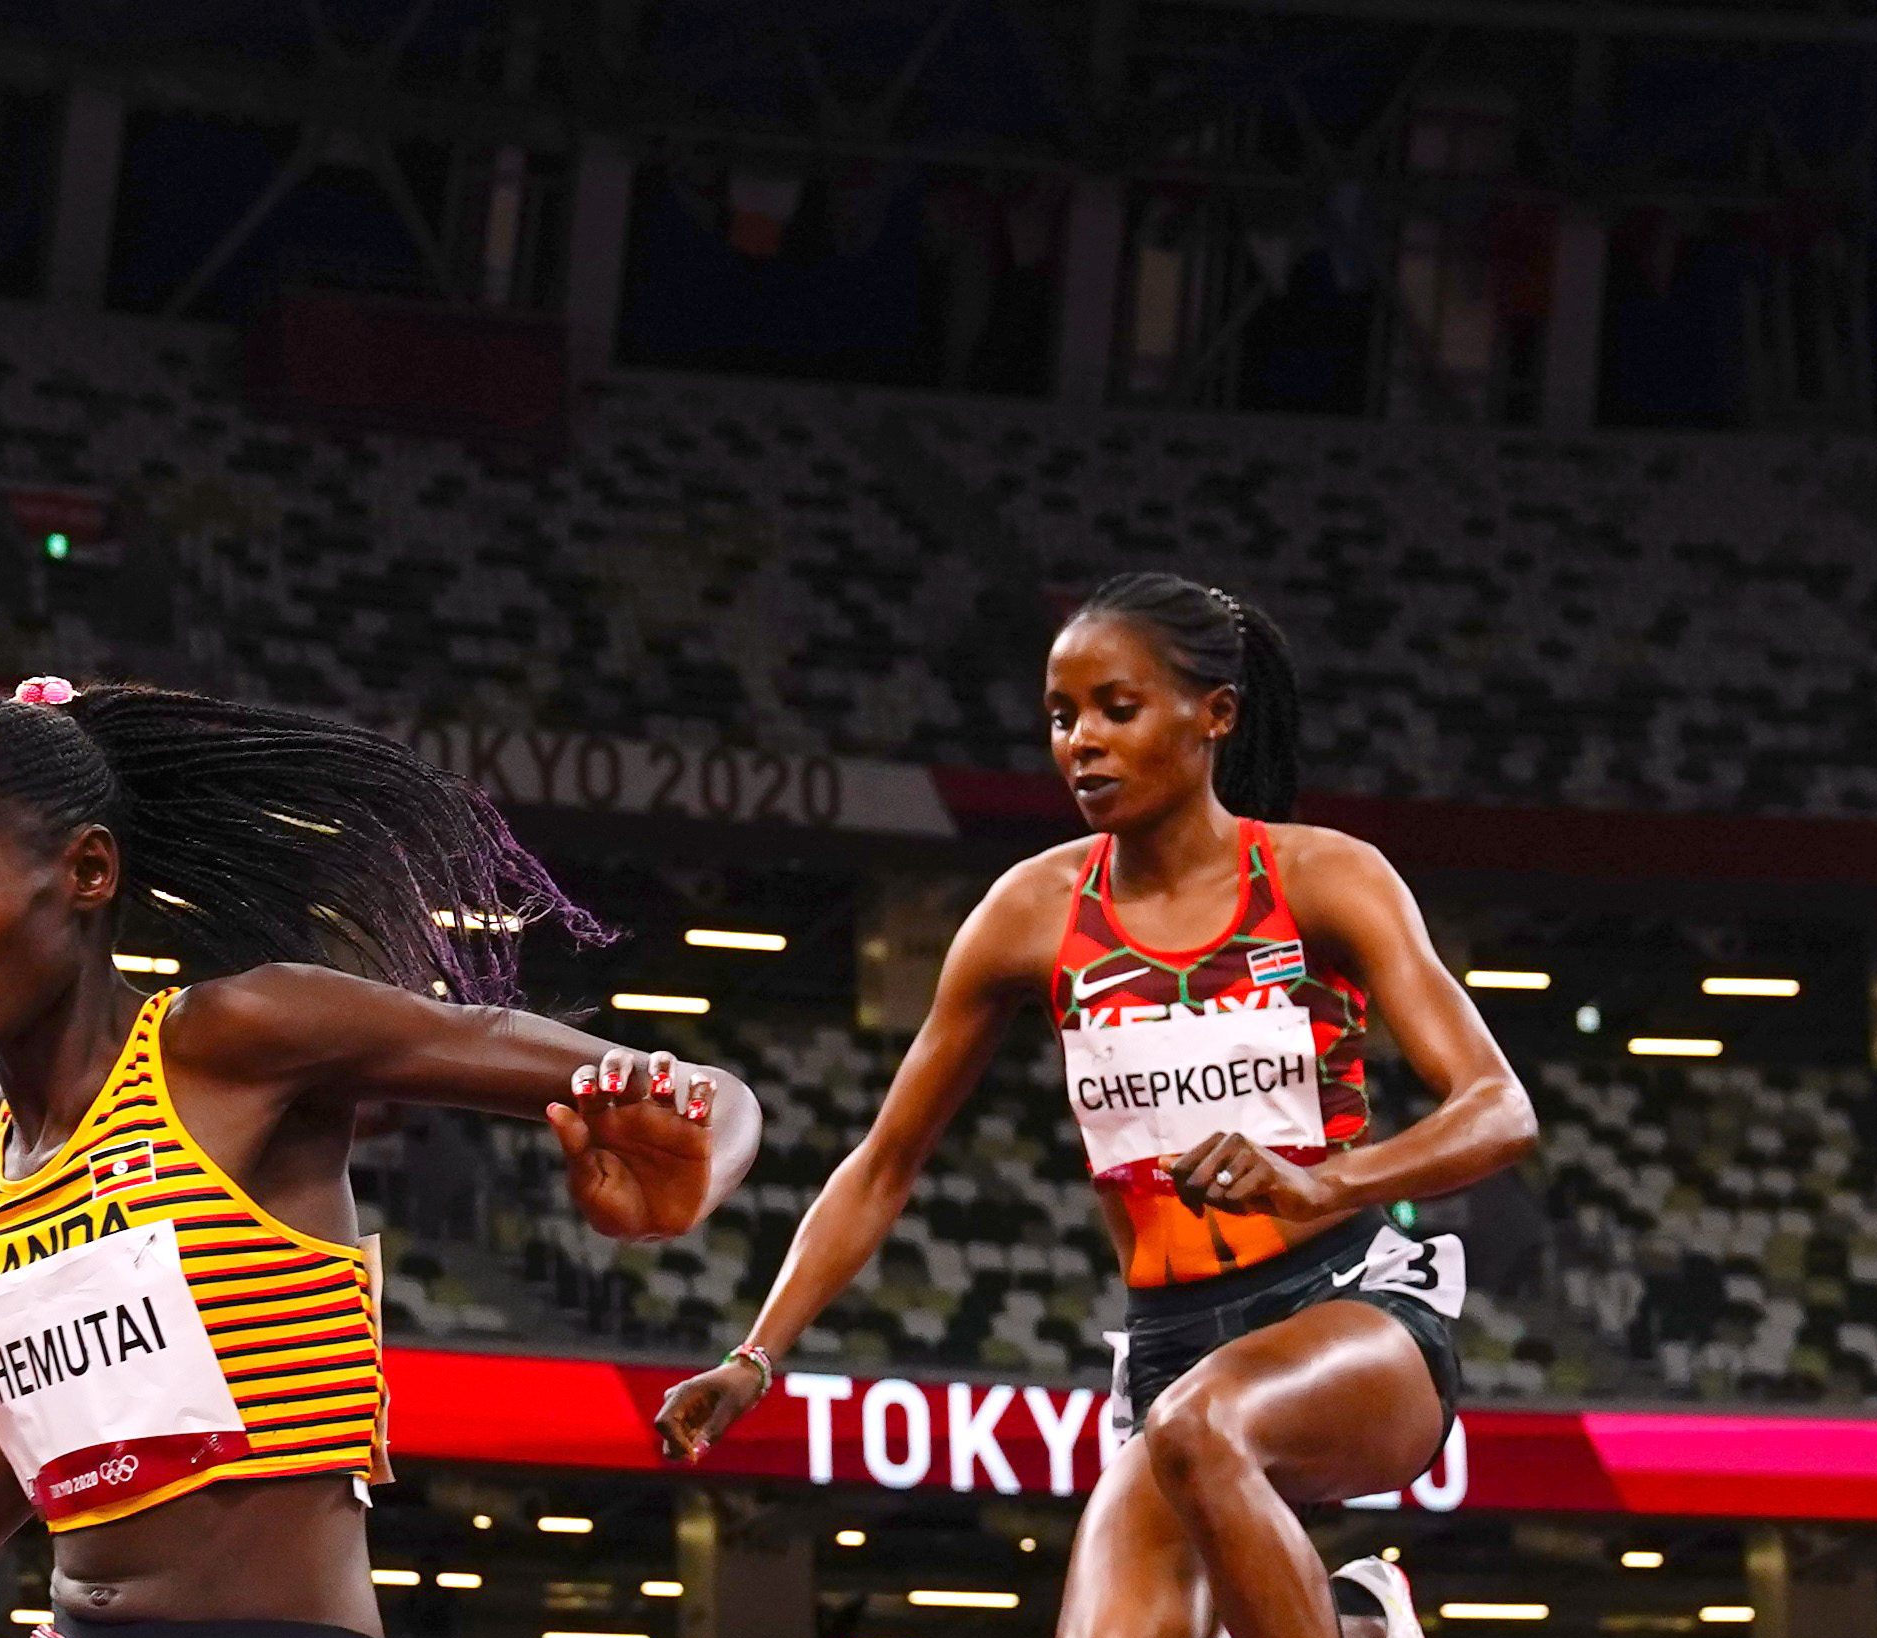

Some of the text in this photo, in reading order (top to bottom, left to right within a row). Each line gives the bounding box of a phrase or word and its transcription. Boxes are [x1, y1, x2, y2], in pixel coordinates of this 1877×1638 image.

[648, 740, 841, 829] 2020
[1078, 1054, 1305, 1111] CHEPKOECH
[785, 1371, 1122, 1497] TOKY
